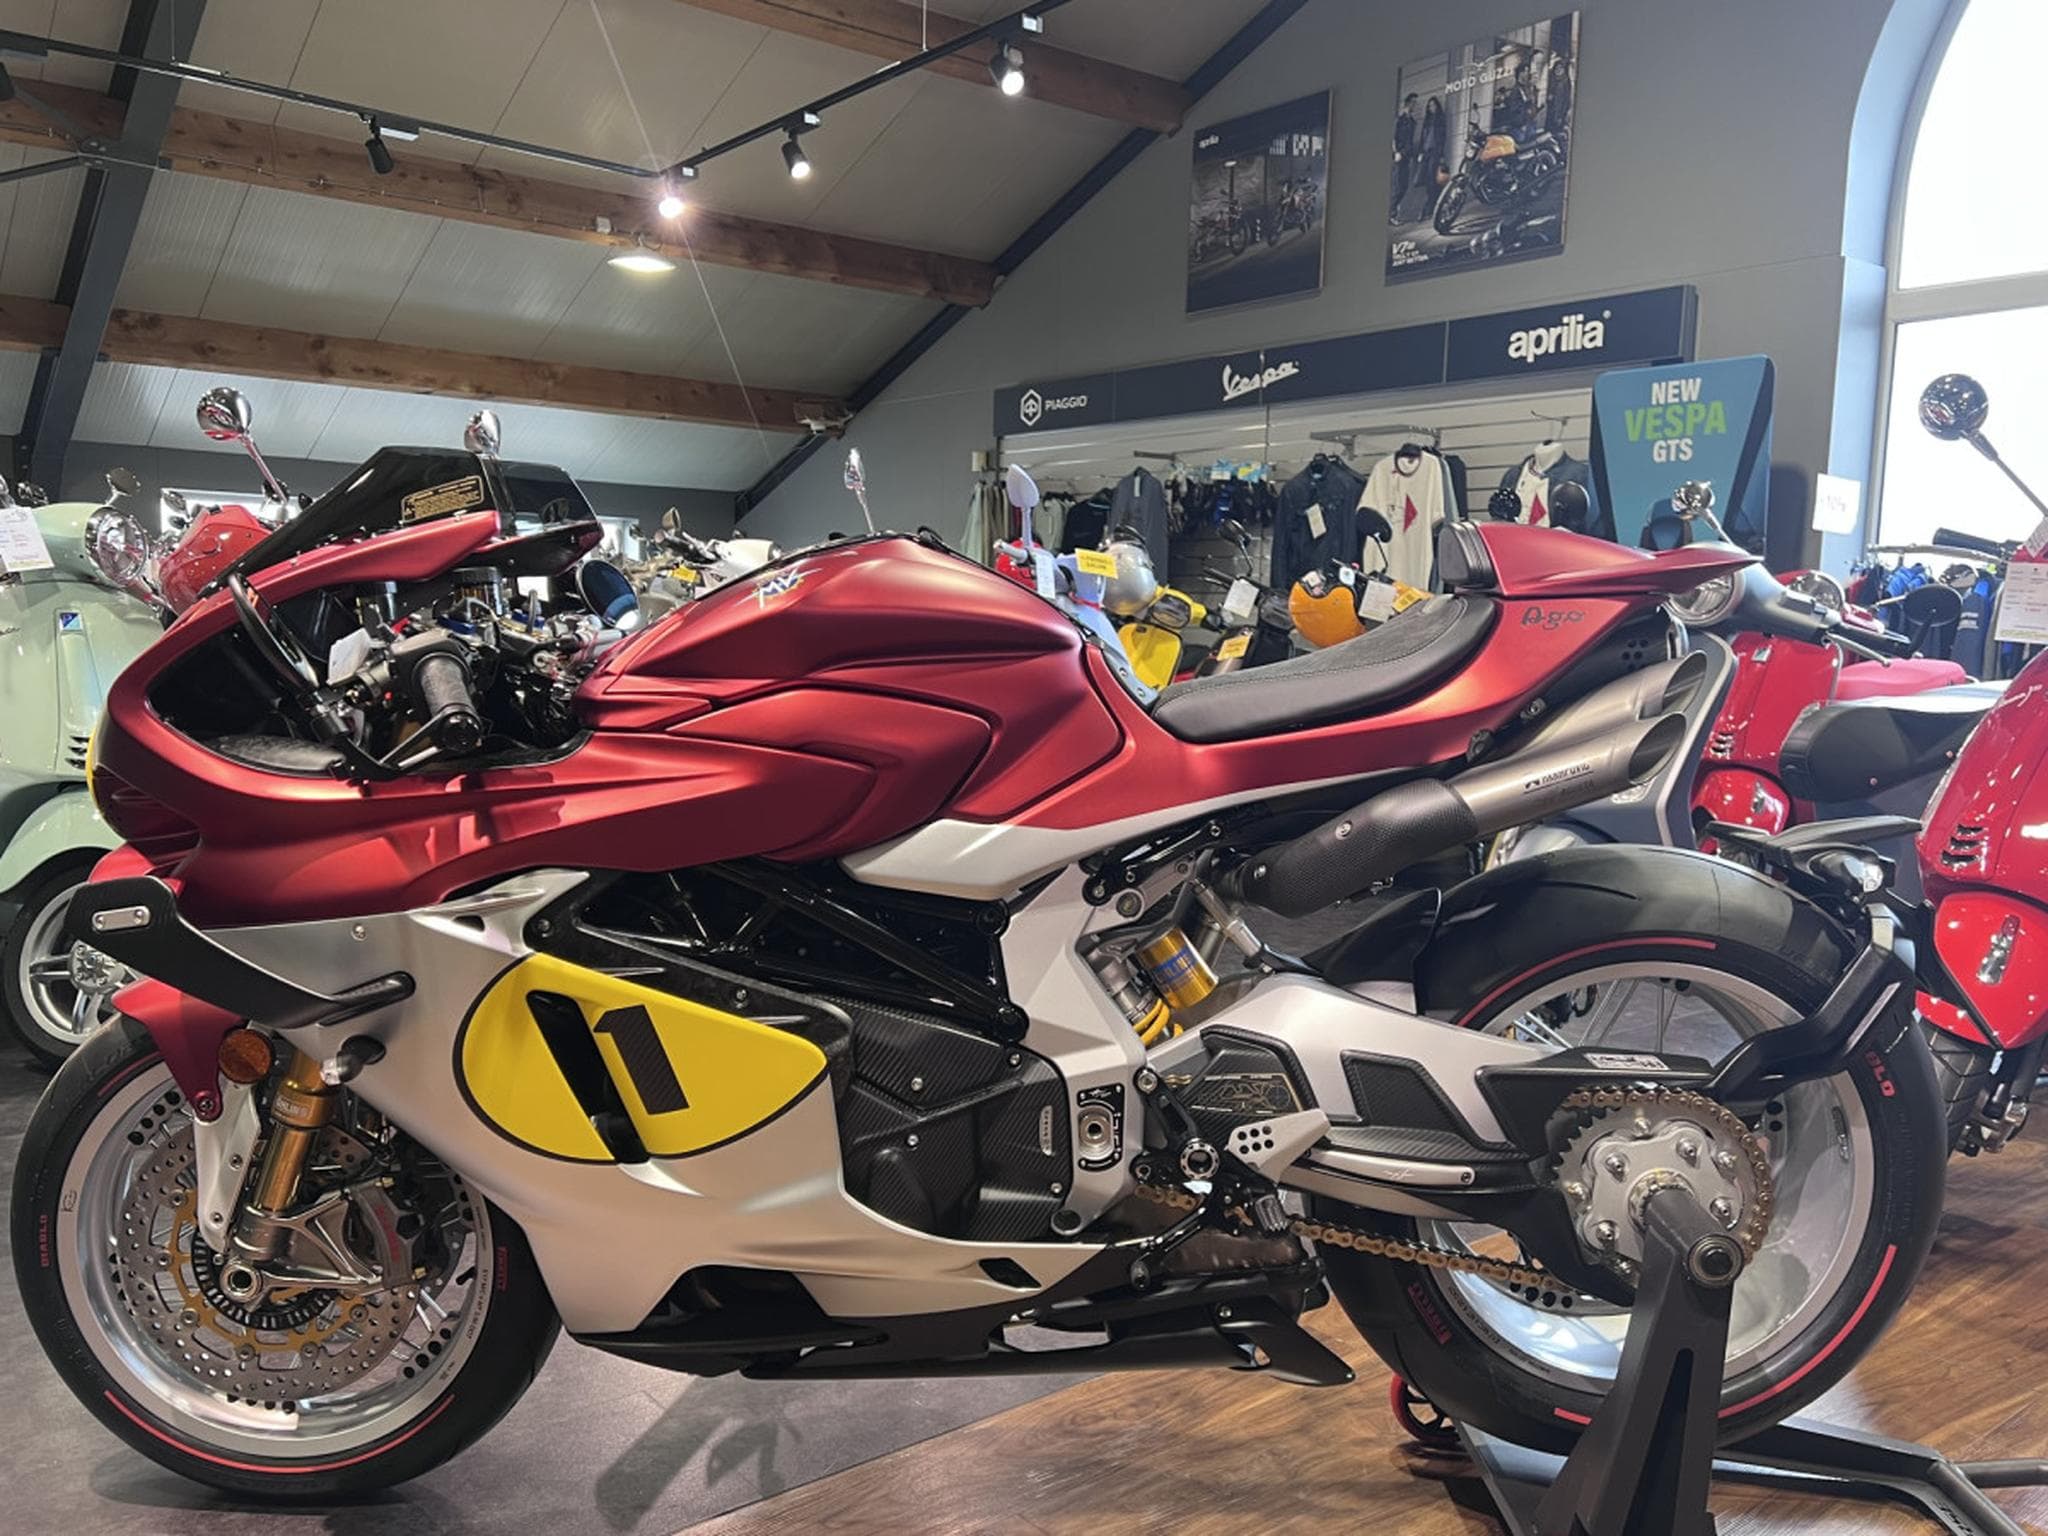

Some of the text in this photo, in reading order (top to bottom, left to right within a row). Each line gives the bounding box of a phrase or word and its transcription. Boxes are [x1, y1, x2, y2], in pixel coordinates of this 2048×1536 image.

[1445, 77, 1476, 94] MOTO
[1508, 314, 1604, 362] aprilia
[1222, 361, 1299, 401] Vespa
[1651, 378, 1702, 405] NEW
[1044, 395, 1088, 411] PIAGGIO
[1623, 402, 1728, 442] VESPA
[1652, 438, 1693, 463] GTS
[593, 1003, 691, 1116] 1
